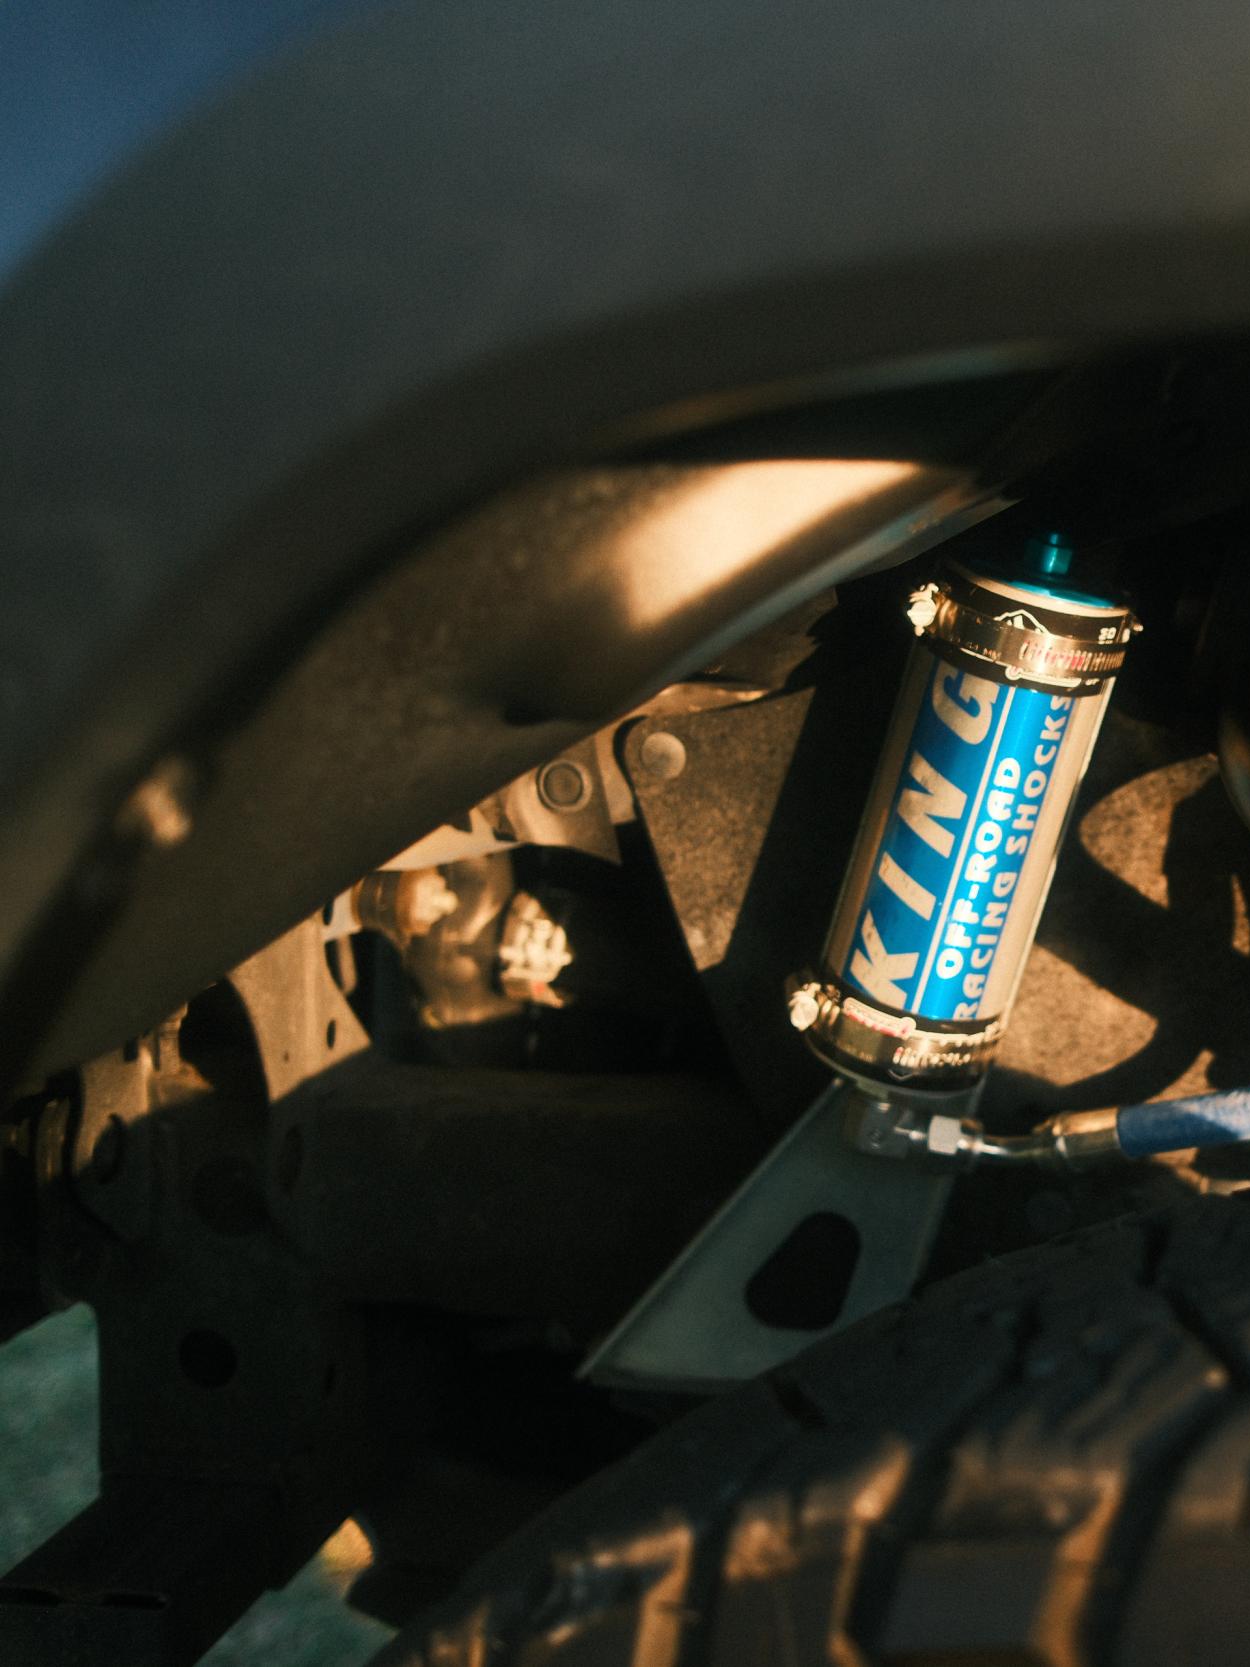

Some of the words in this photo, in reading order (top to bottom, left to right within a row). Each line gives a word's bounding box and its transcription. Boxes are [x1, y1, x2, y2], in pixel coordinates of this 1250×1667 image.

[851, 661, 1000, 1010] KING
[936, 757, 1021, 980] OFF-ROAD
[953, 871, 1018, 1021] RACING
[1004, 695, 1070, 856] SHOCKS
